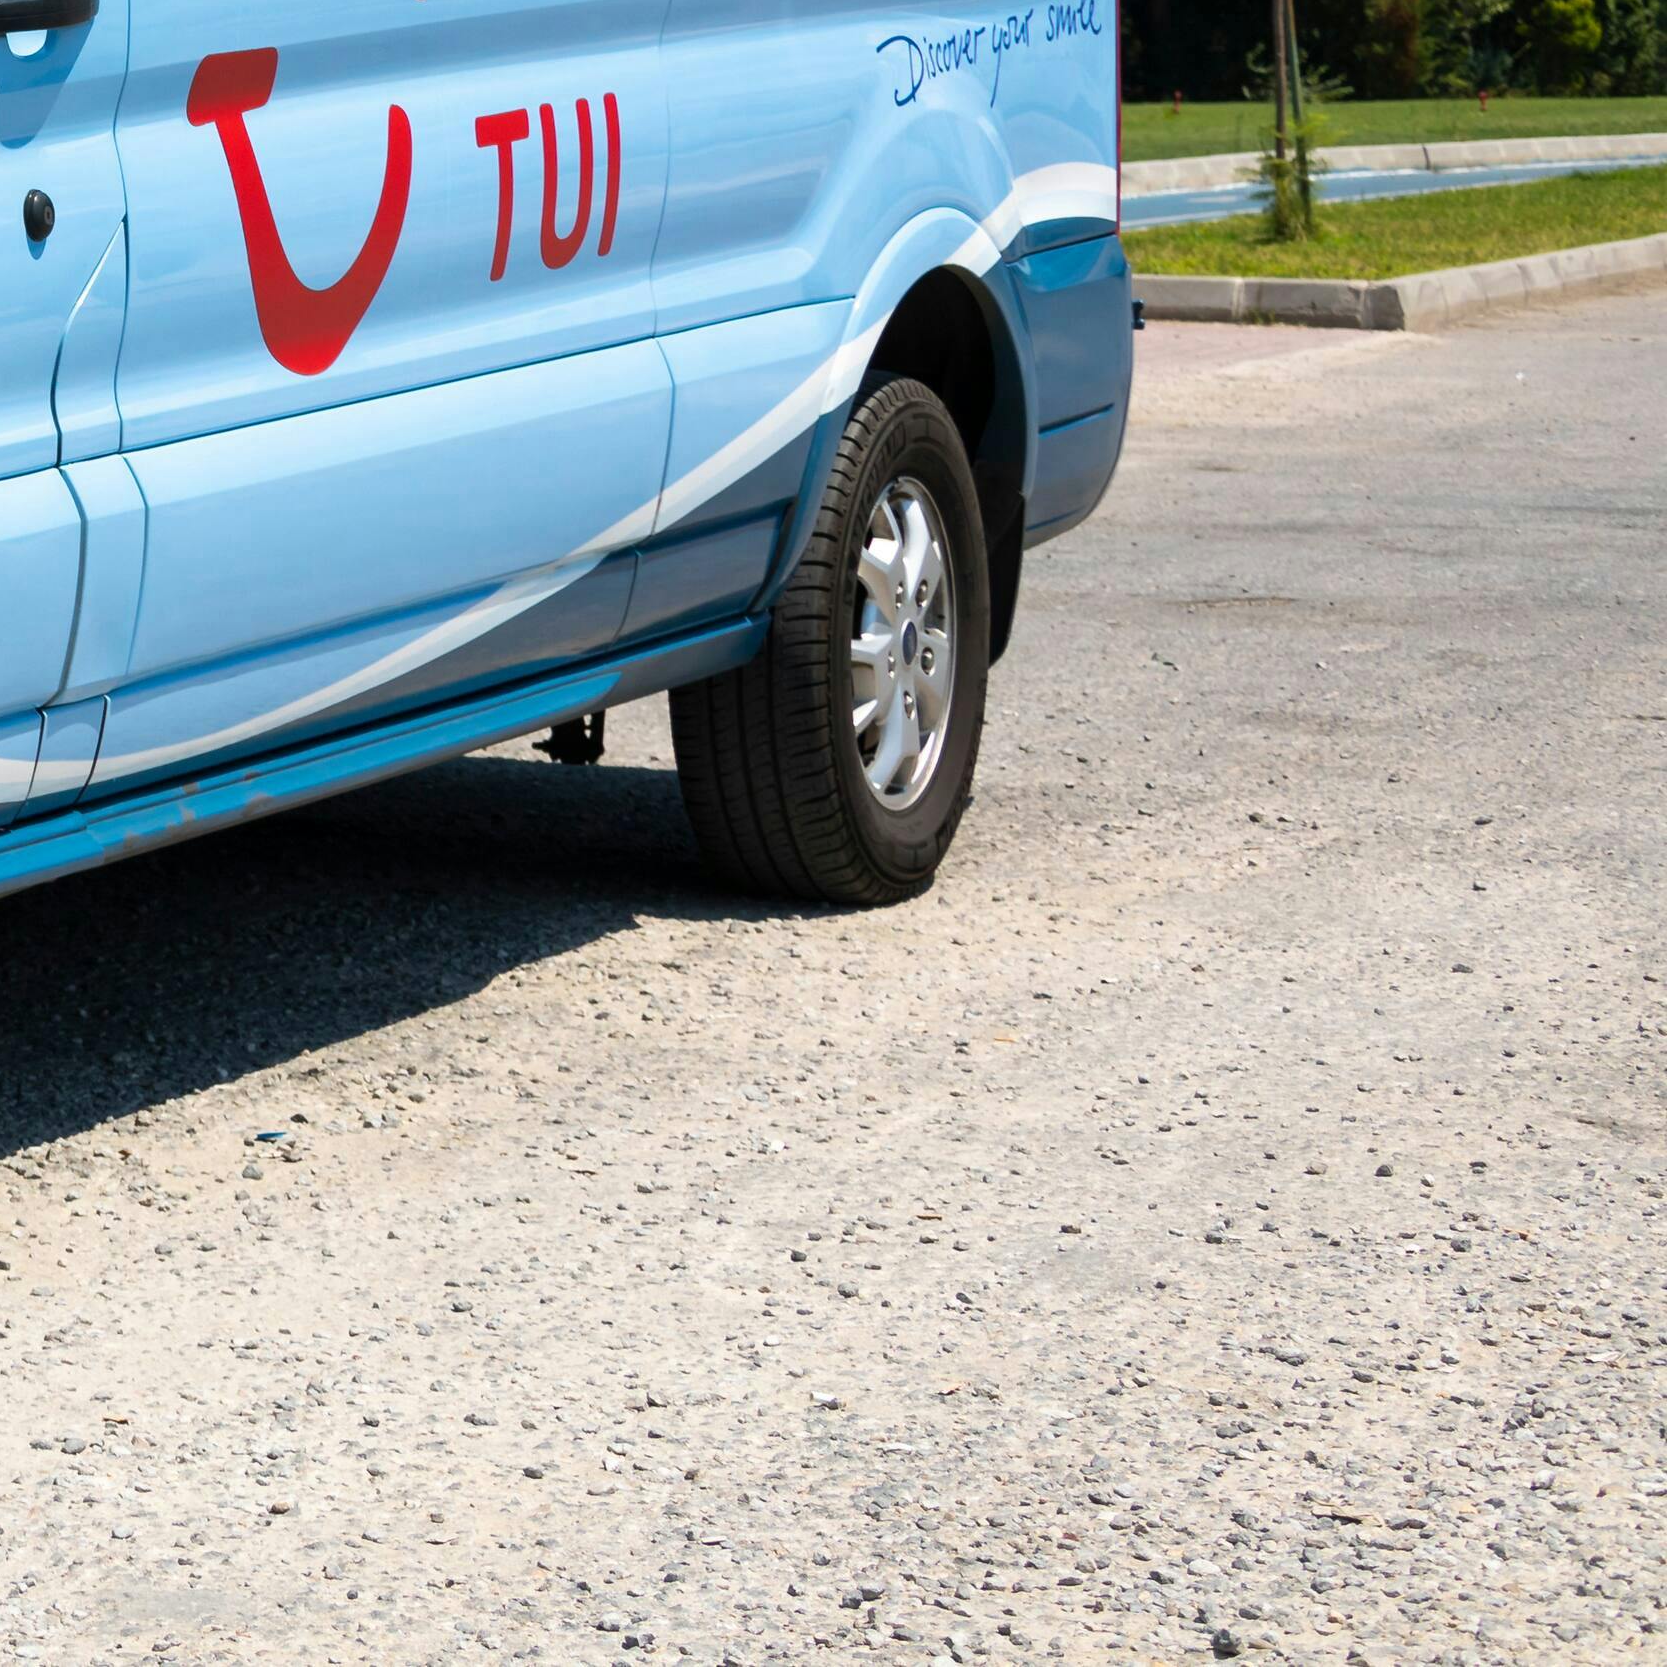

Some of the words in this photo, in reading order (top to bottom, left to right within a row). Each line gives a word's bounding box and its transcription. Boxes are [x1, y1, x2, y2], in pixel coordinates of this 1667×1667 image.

[876, 26, 986, 108] Discover
[990, 8, 1034, 108] your
[474, 92, 621, 281] TUI
